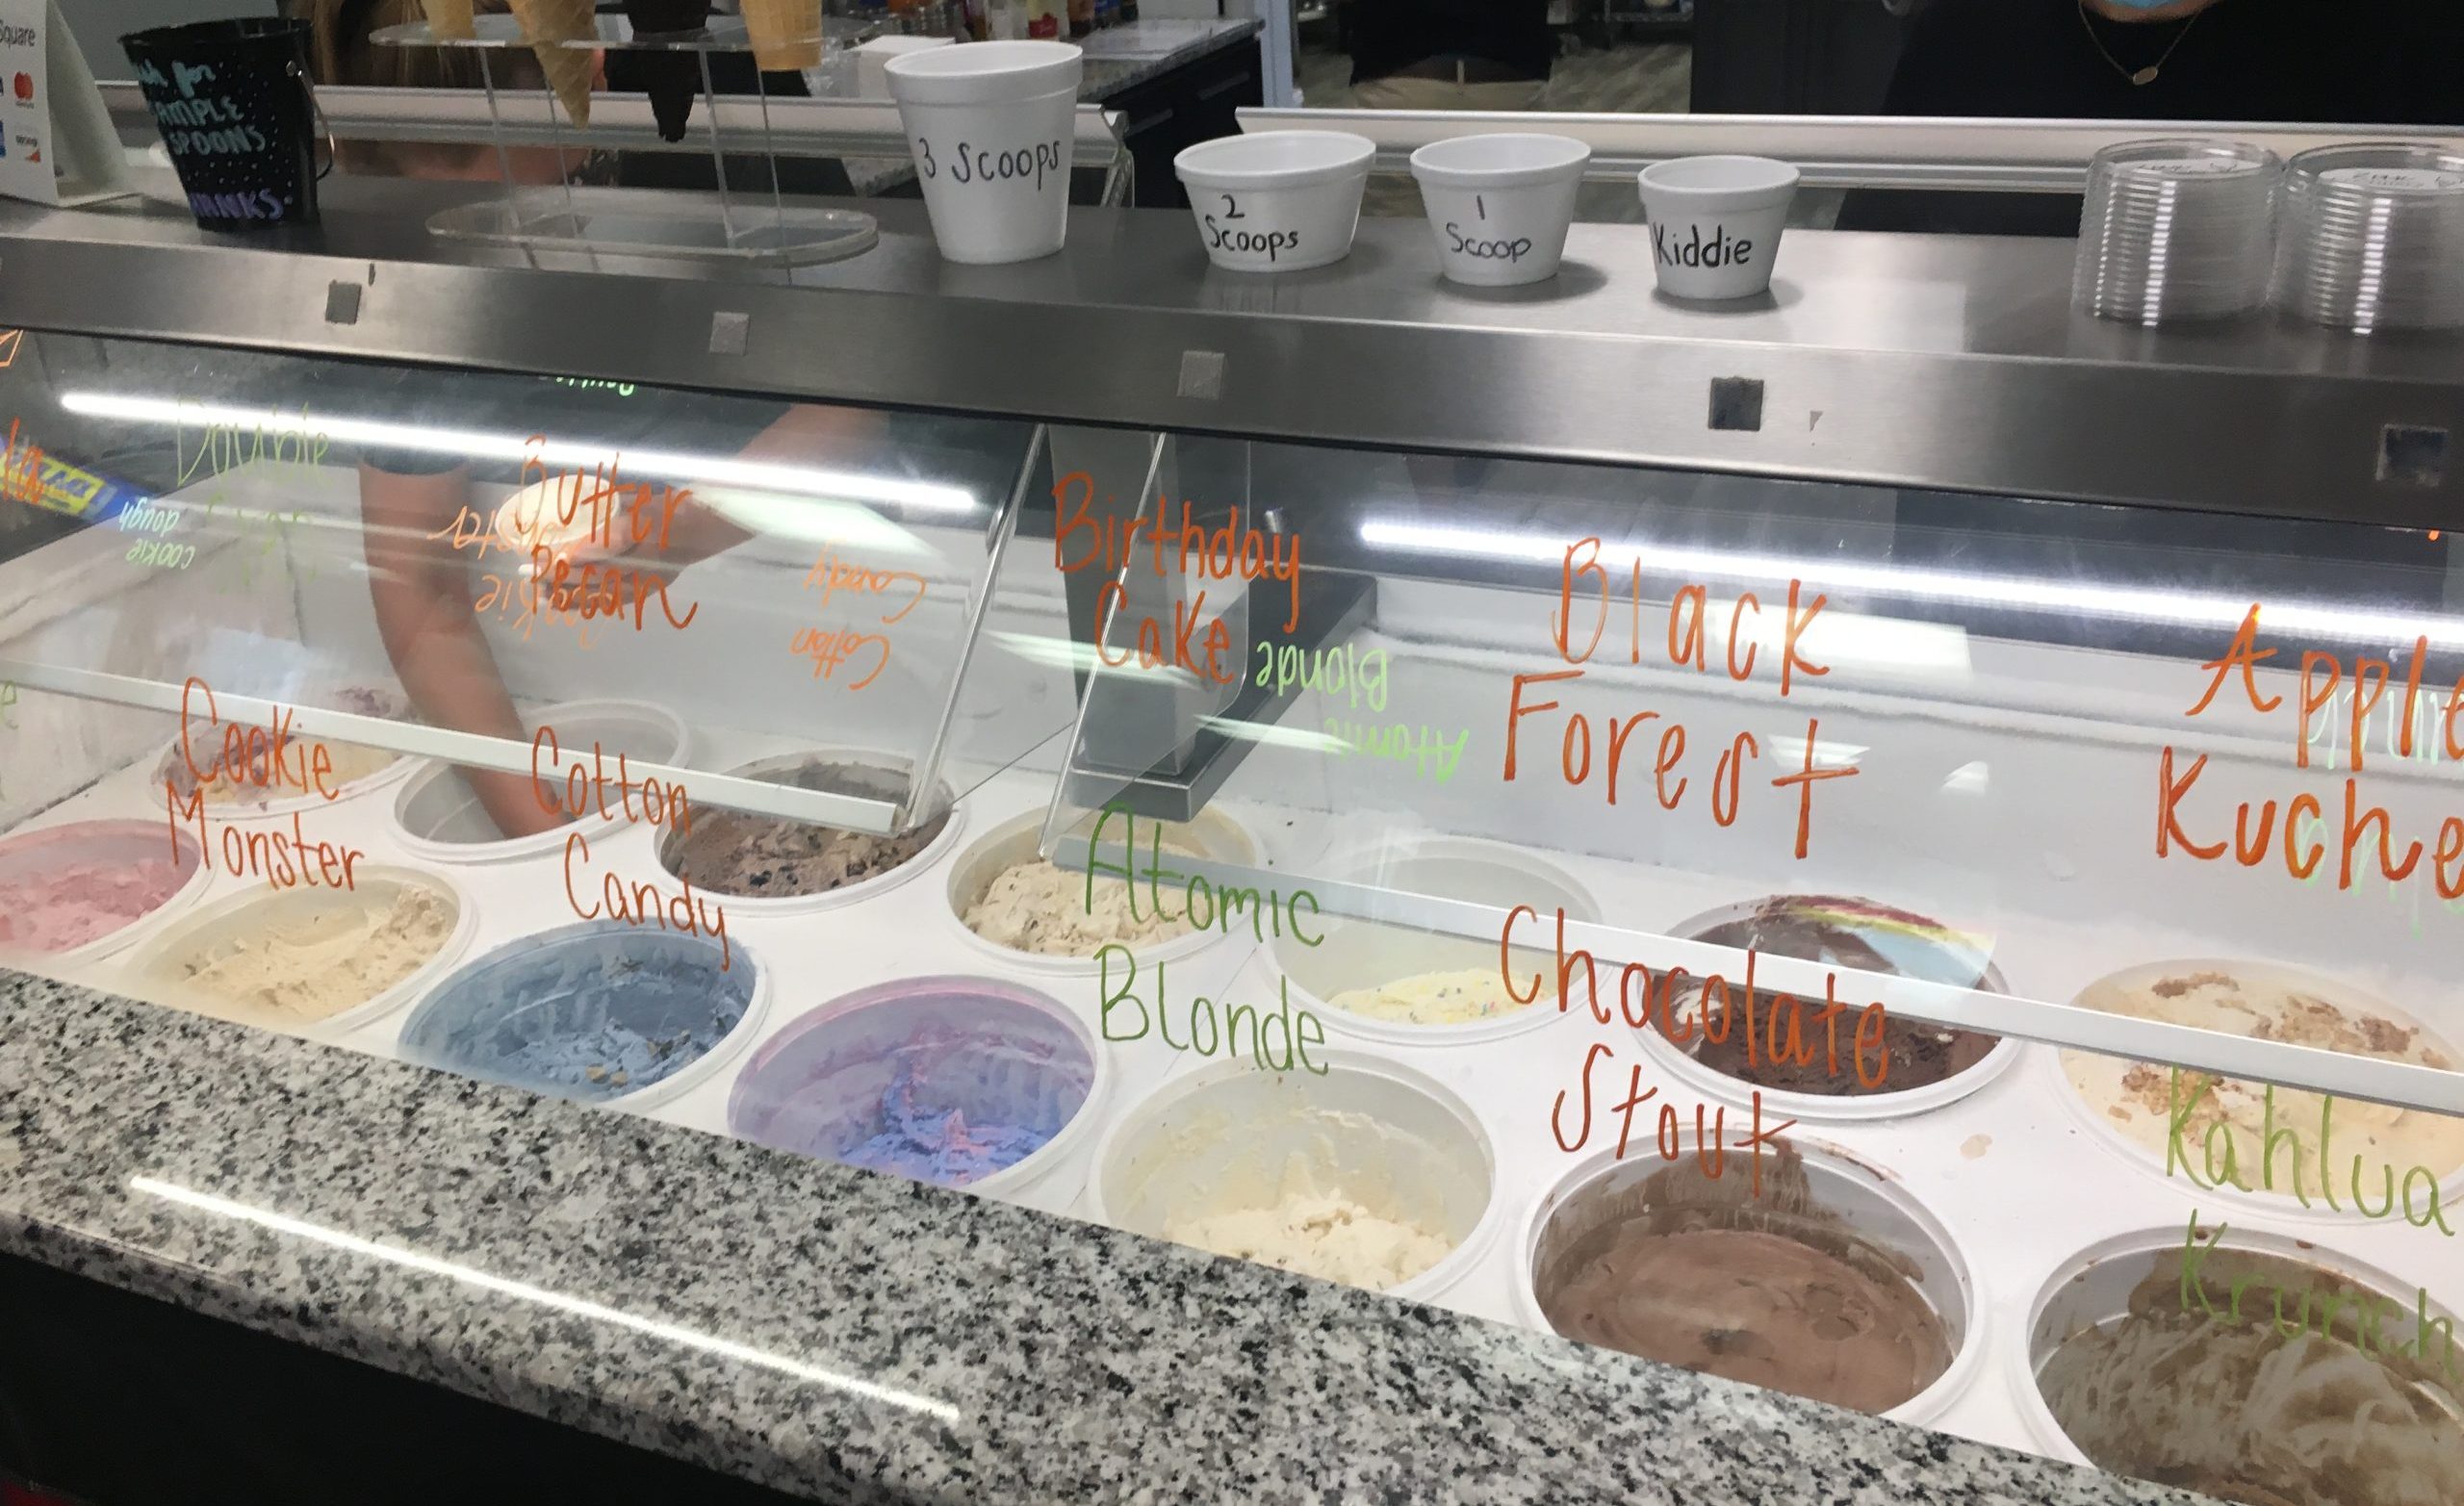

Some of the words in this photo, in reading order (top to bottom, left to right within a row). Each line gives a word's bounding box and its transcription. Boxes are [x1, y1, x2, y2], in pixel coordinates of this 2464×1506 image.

[918, 137, 937, 177] 3
[950, 138, 1061, 191] Scoops
[1221, 194, 1245, 219] 2
[1476, 194, 1485, 222] 1
[1203, 214, 1300, 259] Scoops
[1444, 221, 1533, 265] Scoop
[1651, 221, 1754, 270] Kiddie
[514, 433, 695, 550] Butter
[529, 543, 699, 631] Pecan
[1050, 470, 1301, 635] Birthday
[1093, 580, 1237, 685] Cake
[1551, 536, 1831, 697] Black
[181, 676, 341, 802] Cookie
[530, 725, 695, 838] Cotton
[1503, 670, 1860, 859] Forest
[166, 779, 366, 891] Monster
[1085, 800, 1325, 948] Atomic
[563, 831, 732, 973] Candy
[1092, 943, 1330, 1077] Blonde
[1500, 905, 1890, 1089] Chocolate
[1551, 1042, 1798, 1200] Stout
[2167, 1061, 2456, 1238] Kahlua
[2179, 1208, 2461, 1386] Krunch
